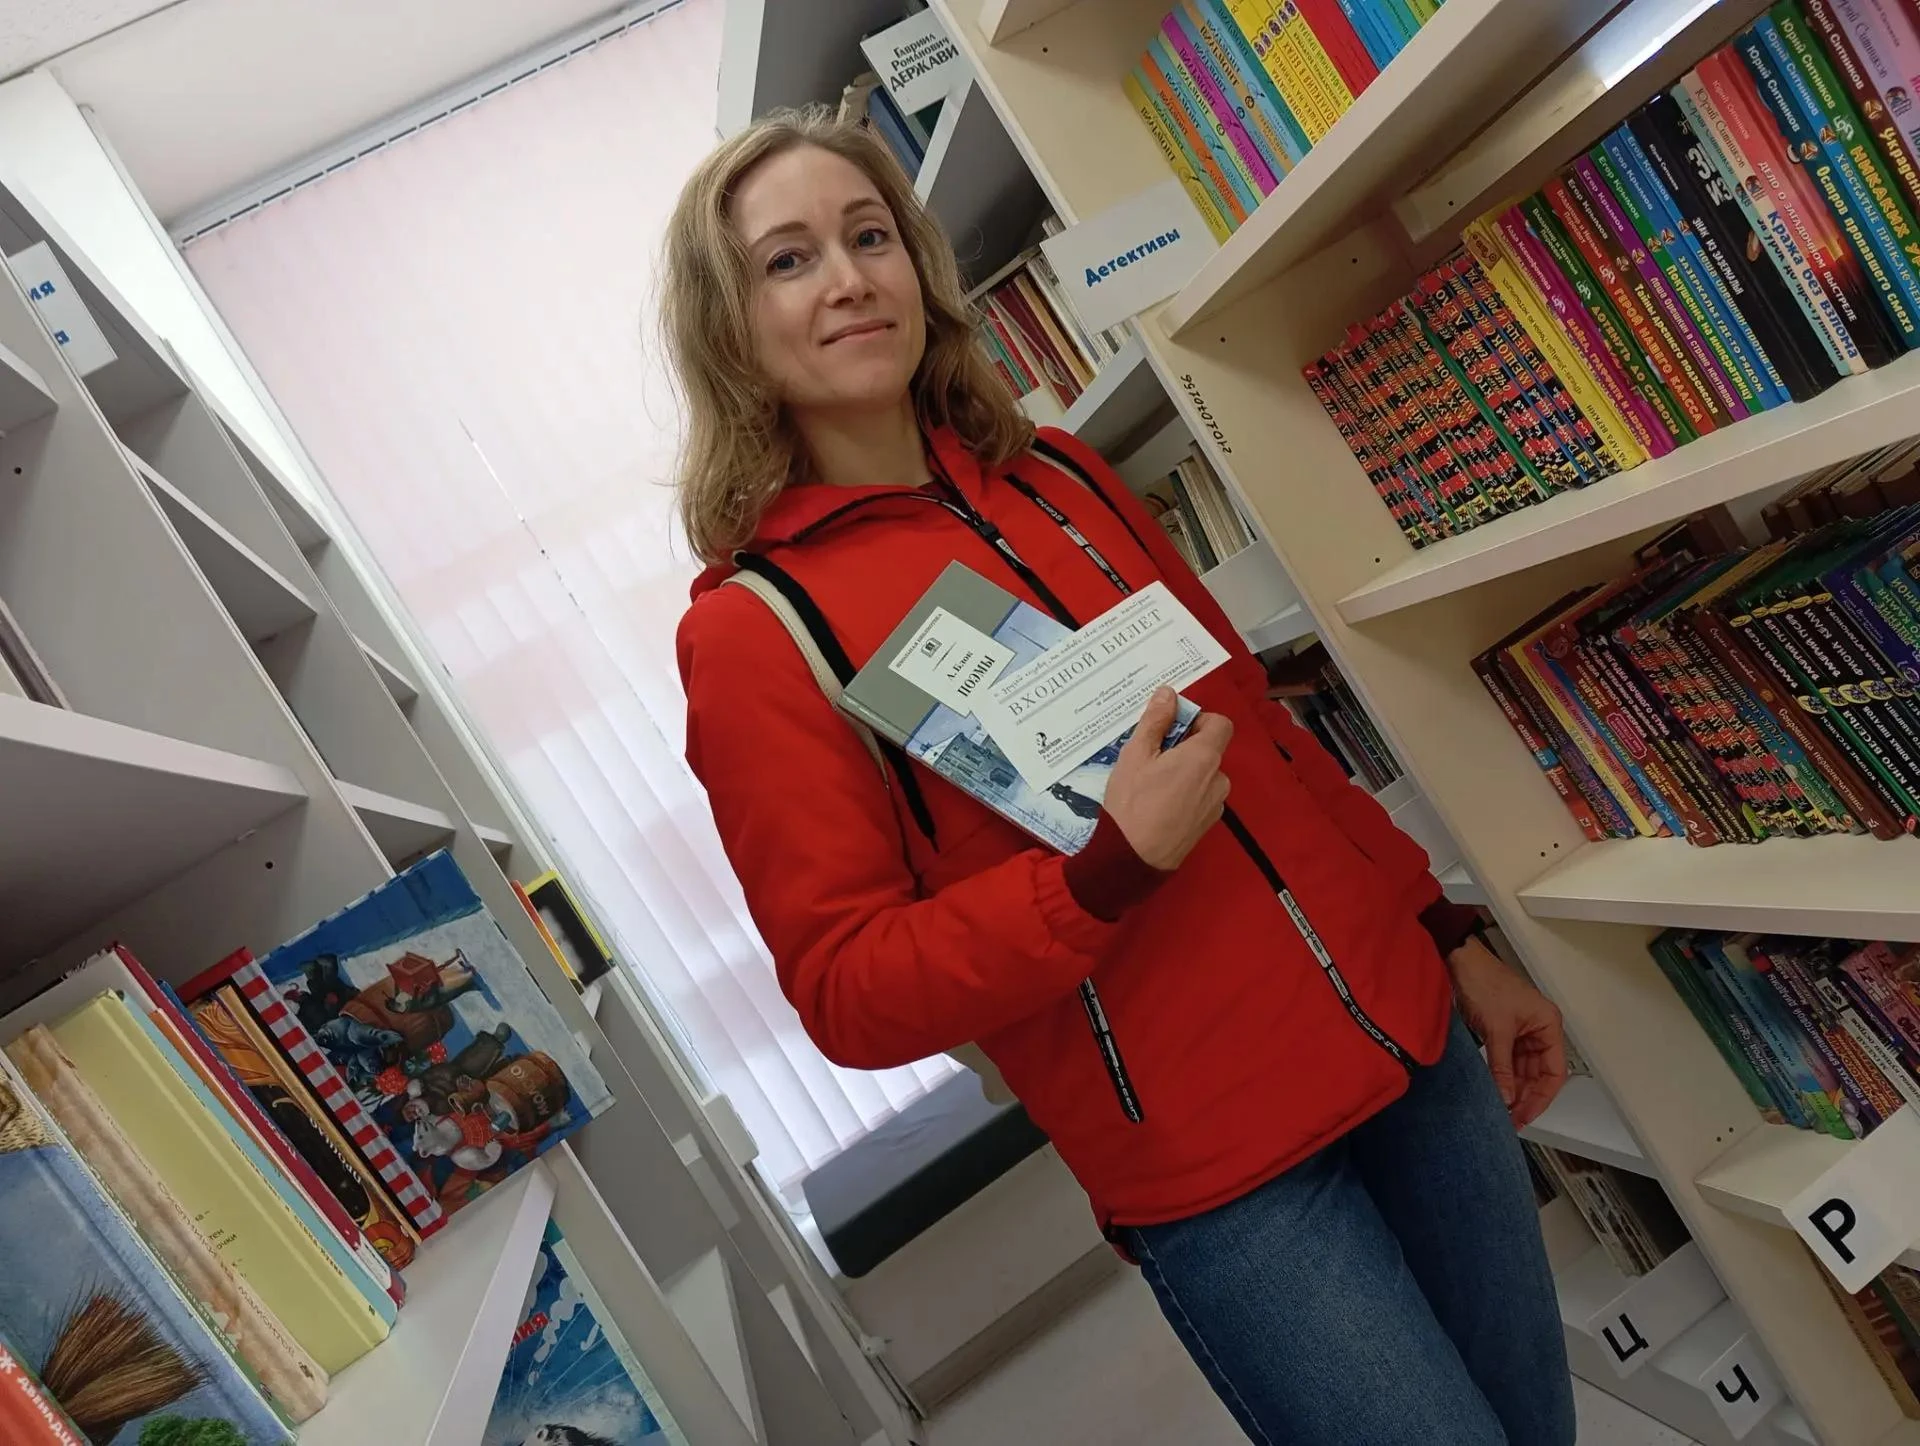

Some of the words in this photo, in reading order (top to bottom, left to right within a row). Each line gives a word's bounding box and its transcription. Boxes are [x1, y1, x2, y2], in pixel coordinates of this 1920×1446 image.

[1778, 17, 1807, 54] Юрий
[1798, 52, 1839, 110] Ситников
[1806, 0, 1835, 34] Юрий
[1826, 32, 1868, 90] Ситников
[889, 44, 960, 92] ДЕРЖАВИ
[1743, 44, 1772, 81] Юрий
[1764, 78, 1802, 133] Ситников
[1761, 27, 1790, 64] Юрий
[1783, 62, 1821, 117] Ситников
[1293, 88, 1305, 102] НА
[1692, 87, 1719, 122] Юрий
[1713, 119, 1748, 169] Ситников
[1595, 154, 1617, 180] Егор
[1611, 177, 1642, 220] Крымов
[1608, 145, 1630, 171] Егор
[1624, 168, 1656, 212] Крымов
[1757, 159, 1780, 190] ДЕЛО
[1775, 190, 1787, 201] О
[1831, 151, 1883, 225] ХВОСТАТЫЕ
[1846, 143, 1913, 239] НИКАКИХ
[1566, 177, 1585, 201] Егор
[1580, 197, 1611, 241] Крымов
[1580, 168, 1600, 192] Егор
[1594, 189, 1626, 233] Крымов
[1690, 215, 1710, 239] ЗНАК
[1704, 238, 1718, 252] ИЗ
[1780, 201, 1828, 270] ЗАГАДОЧНОМ
[1813, 164, 1853, 215] Остров
[1841, 216, 1893, 292] пропавшего
[1884, 291, 1916, 334] смеха
[1085, 228, 1180, 288] Детективы
[1710, 249, 1744, 296] ЗАЗЕРКАЛЬЯ
[1474, 282, 1501, 315] РОБИН
[1665, 263, 1707, 323] Покушение
[1764, 209, 1806, 267] Кража
[1799, 266, 1825, 299] без
[1817, 299, 1859, 359] взлома
[1821, 269, 1858, 322] ВЫСТРЕЛЕ
[1433, 286, 1468, 330] ДЕЛО
[1495, 310, 1507, 322] И
[1676, 253, 1721, 320] ЗАЗЕРКАЛЬЕ
[1714, 318, 1742, 356] ГДЕ-ТО
[1736, 353, 1765, 394] РЯДОМ
[1698, 320, 1714, 338] на
[1398, 311, 1432, 355] КОПИЛКЕ
[1461, 326, 1490, 364] ТЕМНОЕ
[1501, 316, 1549, 383] БЛИЗНЕЦЫ
[1612, 286, 1644, 328] ГЕРОЙ
[1637, 325, 1675, 376] НАШЕГО
[1667, 373, 1704, 424] КЛАССА
[1633, 281, 1661, 316] Тайны
[1650, 312, 1686, 362] древнего
[1679, 357, 1720, 416] подземелья
[1662, 296, 1691, 335] Орешкин
[1688, 339, 1712, 371] стране
[1706, 368, 1736, 409] кентавров
[1450, 338, 1478, 375] СЪЕЛ
[1486, 360, 1511, 393] ОЧЕНЬ
[1490, 331, 1531, 388] МЕШОК
[1590, 302, 1633, 363] ДОТЯНУТЬ
[1629, 362, 1647, 383] ДО
[1641, 381, 1681, 437] СУББОТЫ
[1705, 335, 1753, 403] императрицу
[1426, 389, 1455, 427] МУХА
[1433, 358, 1477, 417] МИЛЛИОН
[1439, 387, 1469, 424] МУХА
[1472, 372, 1494, 399] КТО
[1620, 399, 1631, 410] И
[1335, 419, 1362, 454] СЛЕДУ
[1584, 402, 1608, 435] ВЕРКИН
[1358, 453, 1372, 469] ПО
[1604, 433, 1628, 465] ЭДУАРД
[1784, 610, 1809, 640] ГУСЕВ
[1803, 605, 1832, 641] КЕЛЛИ
[1876, 585, 1910, 627] КАМНЯ
[1742, 623, 1768, 653] ГУСЕВ
[1763, 615, 1787, 644] ГУСЕВ
[955, 653, 997, 698] ПОЭМЫ
[1003, 649, 1101, 718] ВХОДНОЙ
[1098, 607, 1165, 656] БИЛЕТ
[1763, 647, 1799, 692] ВАЛЕРИЙ
[1783, 638, 1820, 683] ВАЛЕРИЙ
[1805, 634, 1841, 679] ВАЛЕРИЙ
[1831, 638, 1865, 679] ФИОНА
[1624, 679, 1652, 715] НОЧНОГО
[1649, 711, 1671, 737] СТУКА
[1702, 704, 1739, 752] ЗАГАДКА
[1862, 703, 1891, 740] ПИРАТОВ
[1727, 710, 1768, 763] ЗАГАДКА
[1842, 705, 1883, 757] ВЕСЕЛЬЯ
[1849, 747, 1877, 782] КОТОРЫЕ
[1880, 752, 1908, 786] КИЛО
[1836, 1065, 1863, 1099] ПОИСКАХ
[1808, 1198, 1856, 1264] Р
[1602, 1313, 1649, 1362] Ц
[1715, 1364, 1760, 1403] Ч
